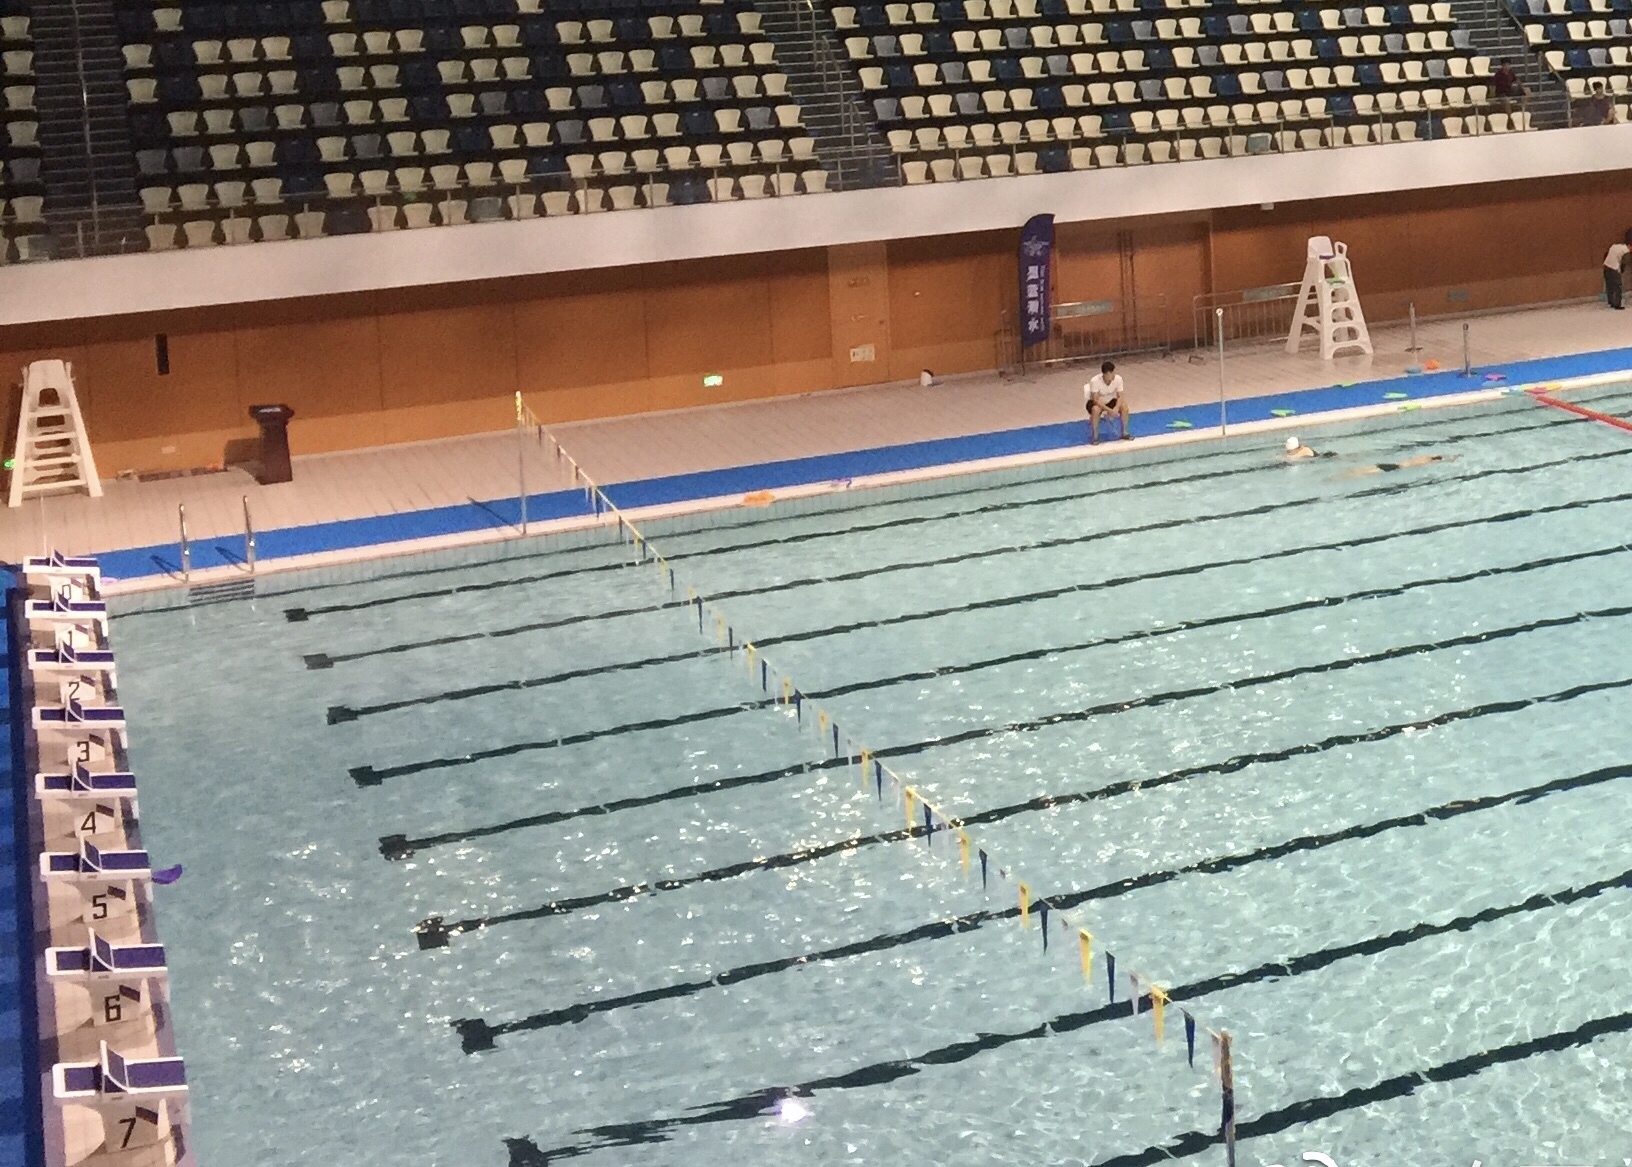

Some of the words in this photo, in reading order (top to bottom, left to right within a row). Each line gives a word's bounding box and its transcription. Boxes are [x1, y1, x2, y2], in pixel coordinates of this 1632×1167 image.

[62, 584, 71, 600] 0
[68, 681, 80, 700] 2
[77, 741, 90, 762] 3
[81, 811, 96, 834] 4
[93, 893, 107, 920] 5
[105, 994, 121, 1022] 6
[118, 1117, 136, 1148] 7
